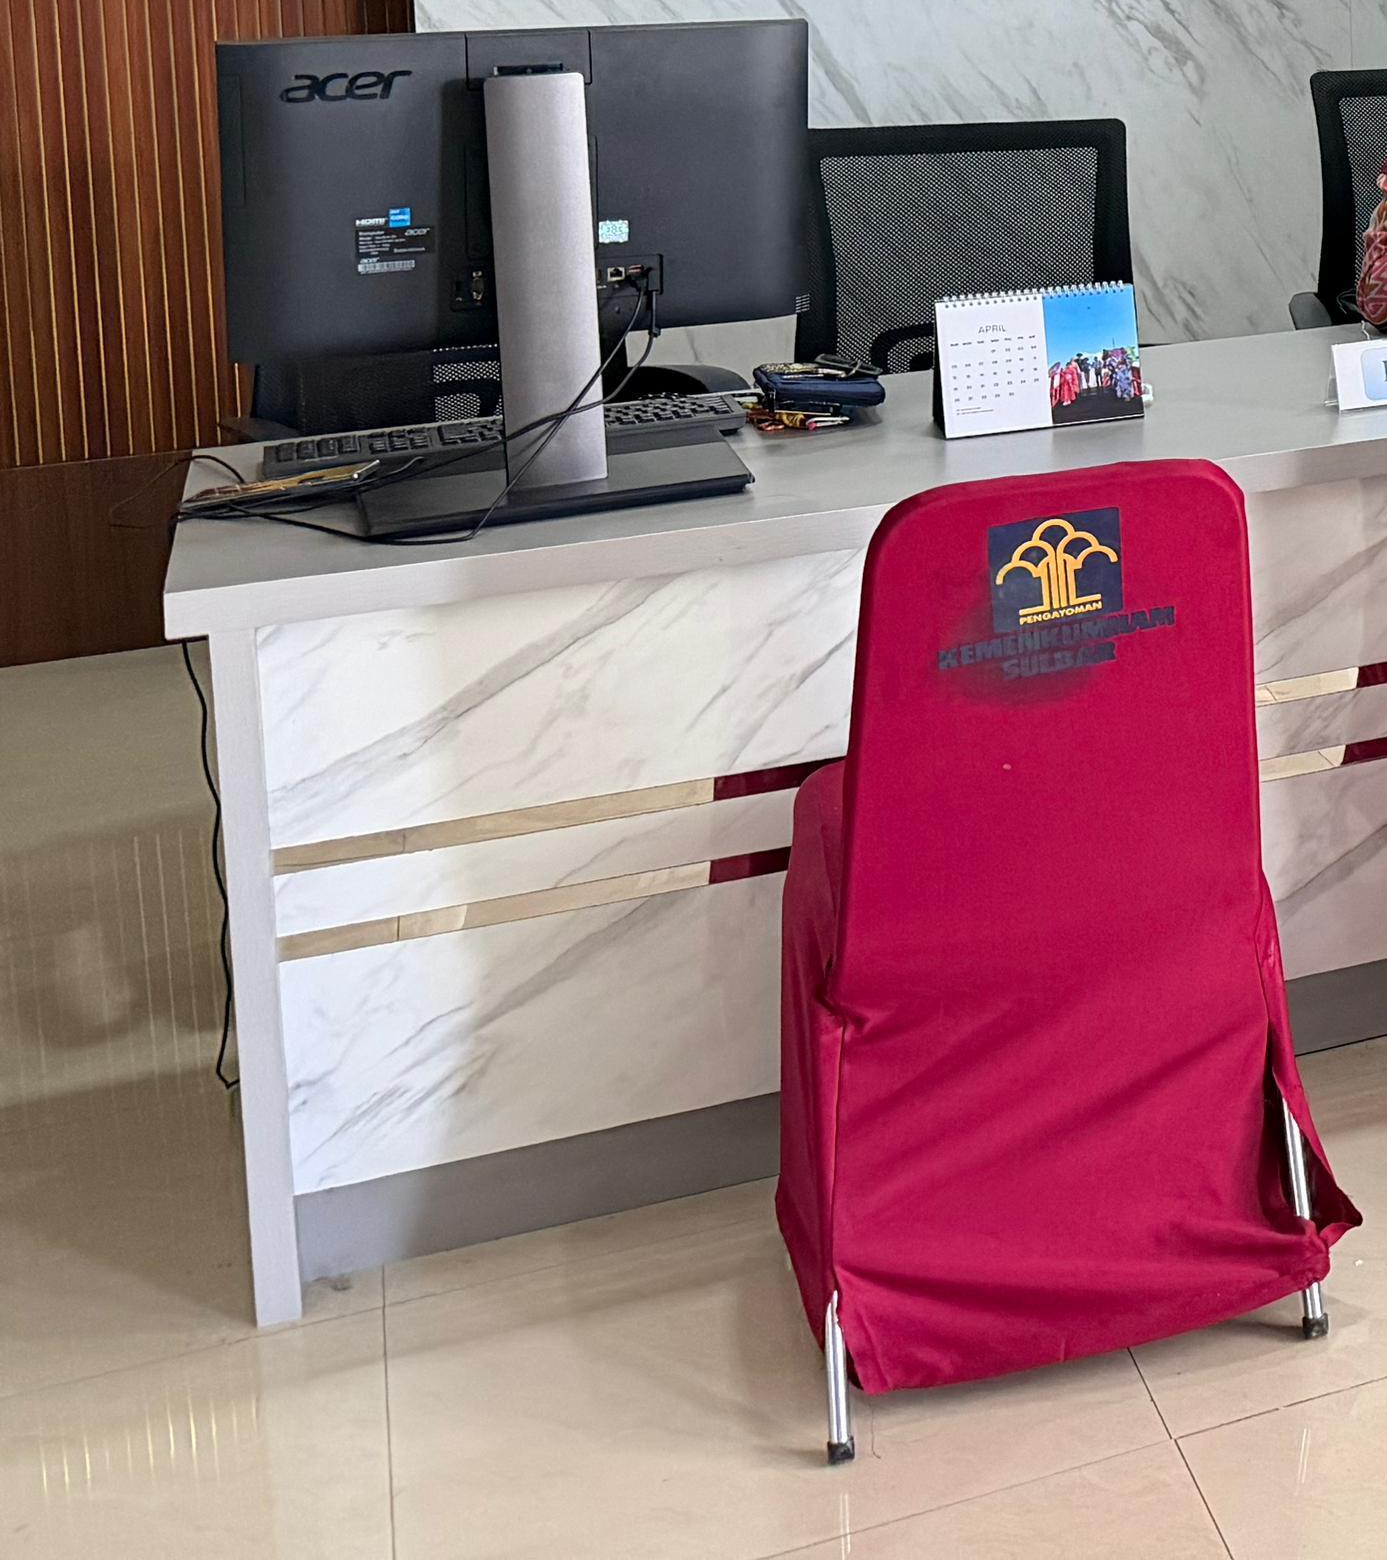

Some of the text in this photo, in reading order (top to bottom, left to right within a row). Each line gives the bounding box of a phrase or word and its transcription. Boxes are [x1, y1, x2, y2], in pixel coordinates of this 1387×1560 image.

[280, 70, 412, 103] acer
[978, 324, 1006, 334] APRIL
[1019, 601, 1102, 626] PENGAYOMAN
